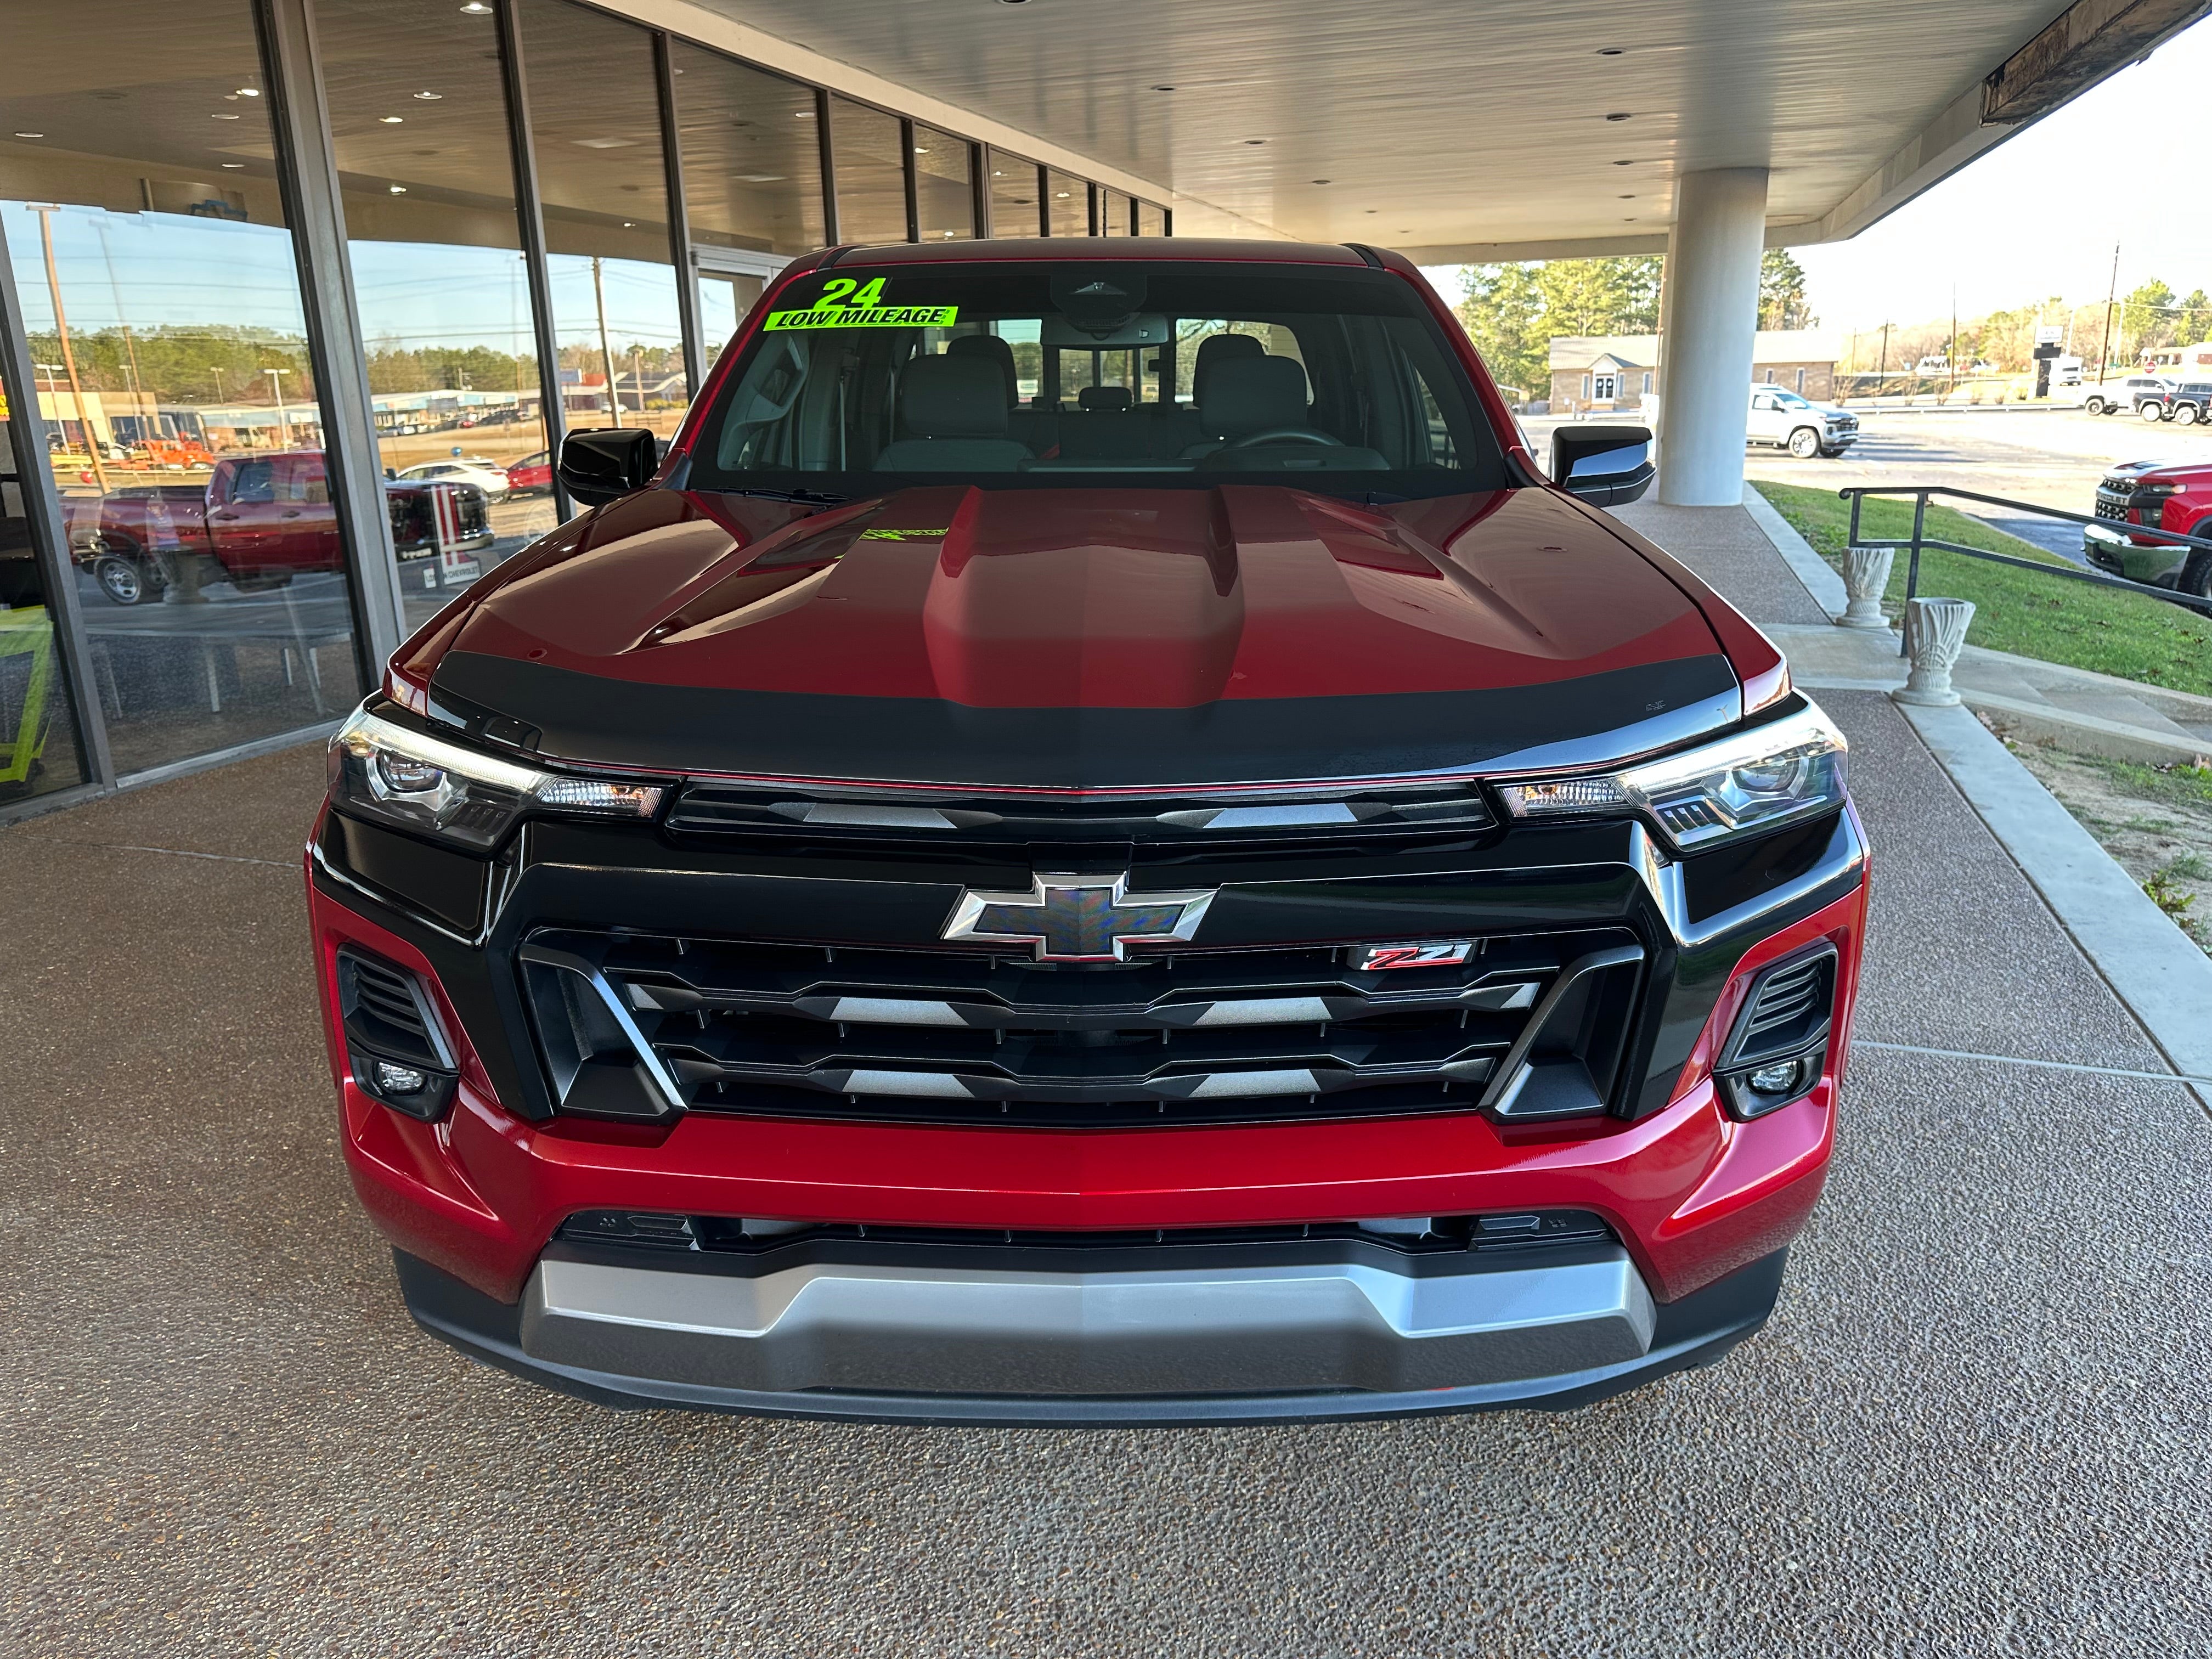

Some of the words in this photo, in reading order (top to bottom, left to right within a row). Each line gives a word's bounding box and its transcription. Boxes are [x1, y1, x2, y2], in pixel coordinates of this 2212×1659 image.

[813, 278, 887, 310] 24
[775, 311, 837, 328] LOW
[835, 308, 950, 325] MILEAGE
[1361, 944, 1472, 970] Z71
